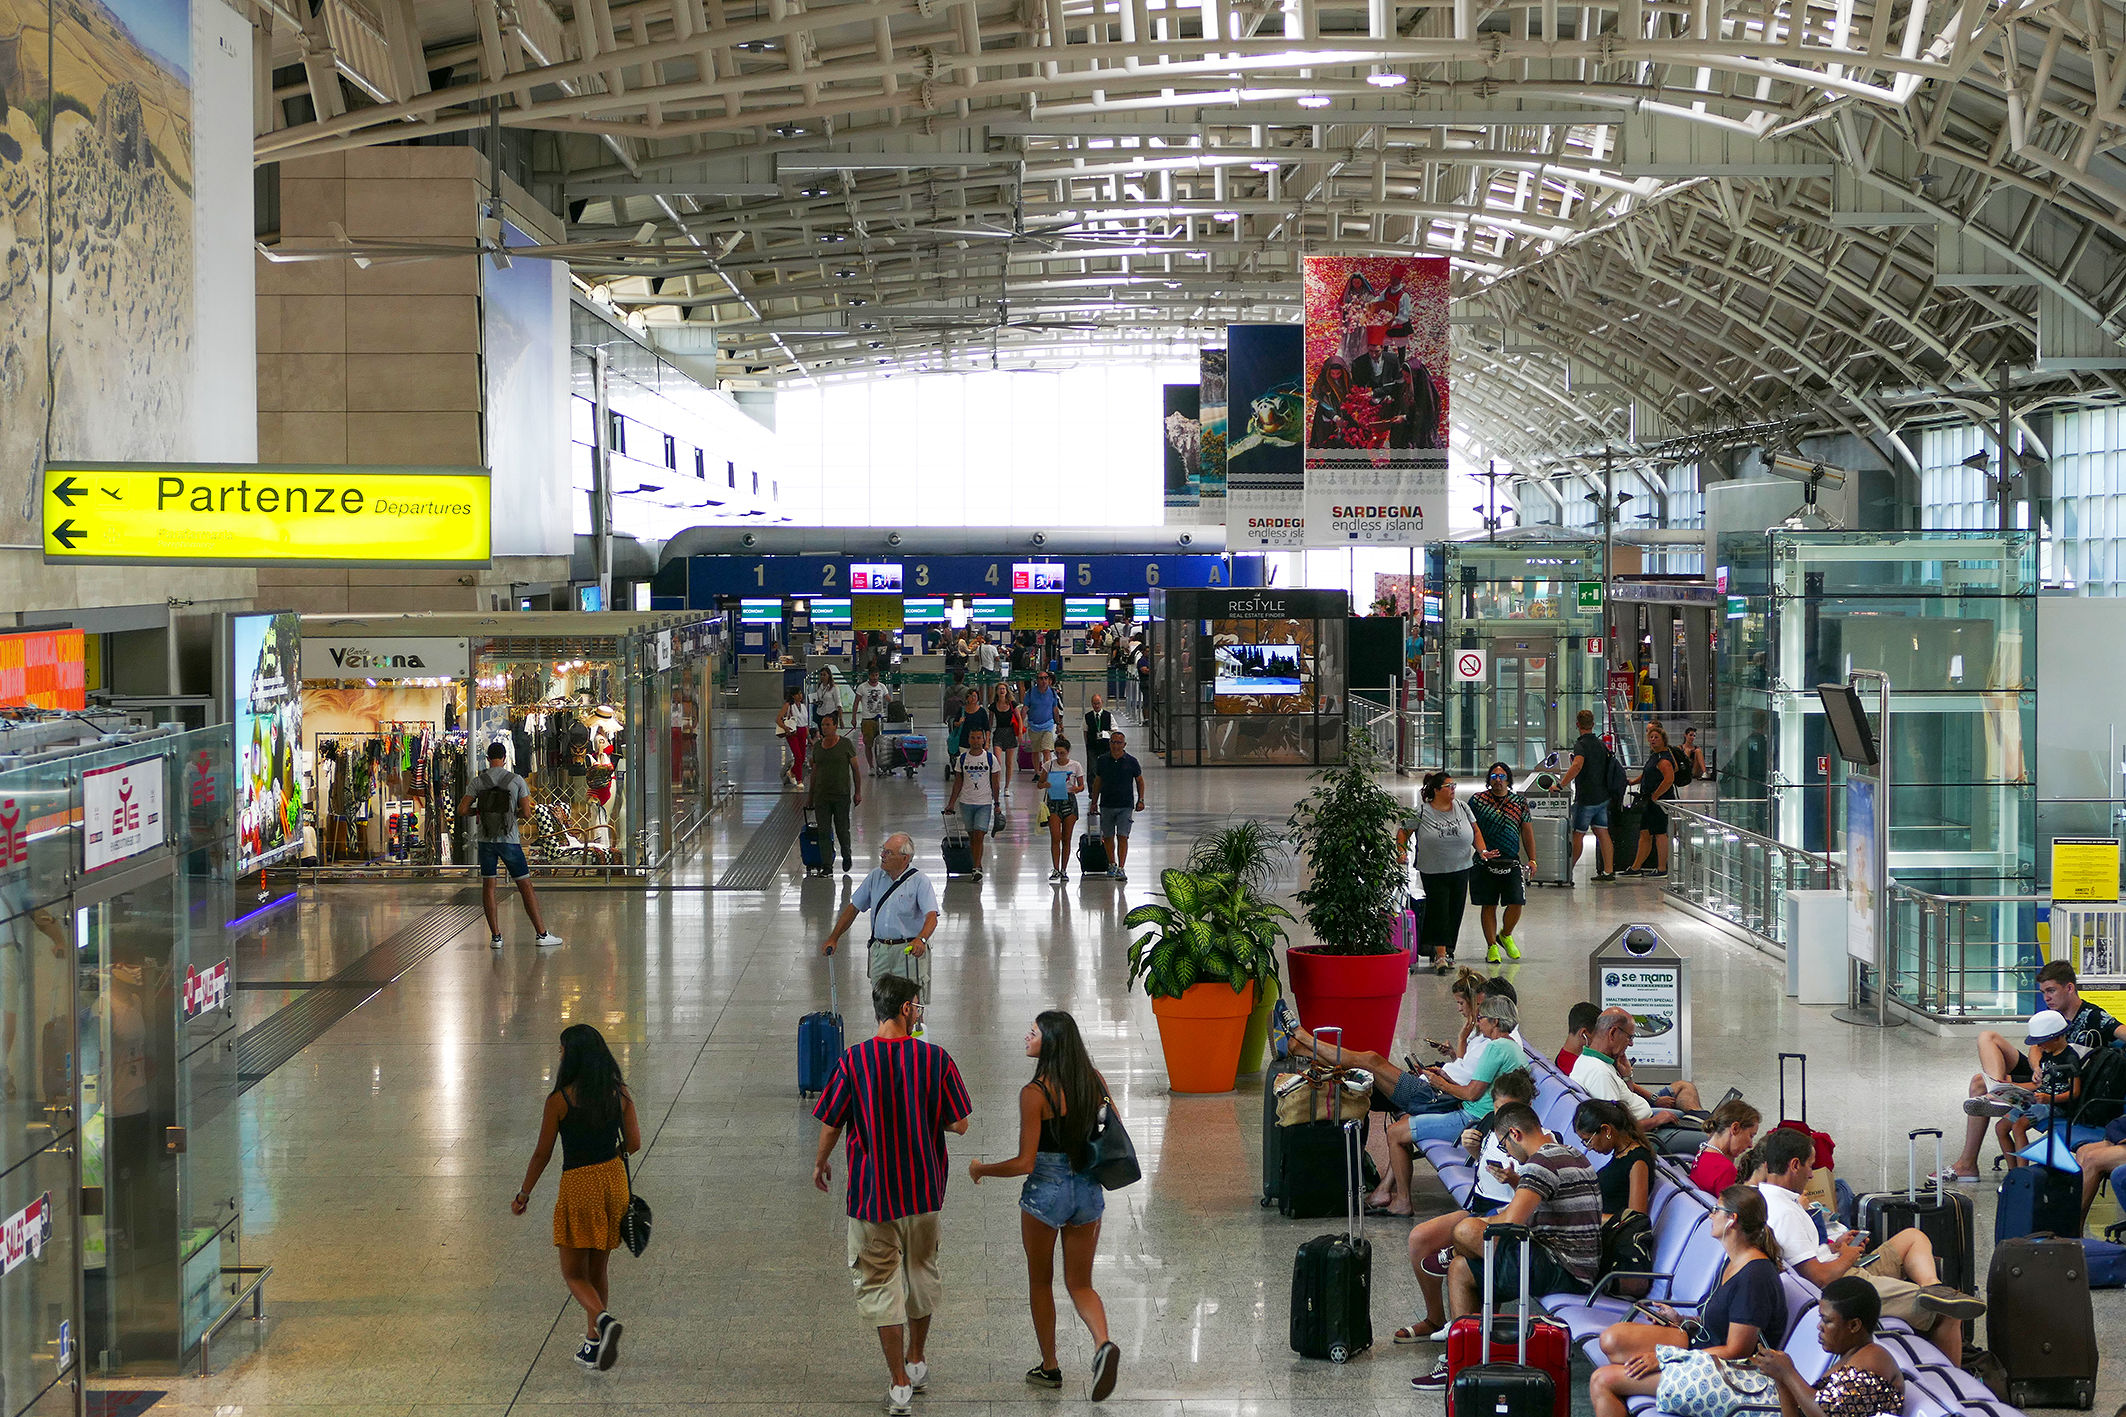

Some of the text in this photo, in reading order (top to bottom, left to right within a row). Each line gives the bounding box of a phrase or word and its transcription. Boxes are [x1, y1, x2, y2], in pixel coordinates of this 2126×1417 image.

[158, 477, 471, 518] Partenze Departures
[1332, 506, 1424, 518] SARDEGNA
[1248, 529, 1287, 538] endless
[1332, 518, 1424, 531] endless island
[753, 564, 764, 587] 1
[822, 564, 837, 587] 2
[915, 564, 930, 587] 3
[985, 564, 999, 586] 4
[1078, 563, 1091, 586] 5
[1146, 563, 1159, 586] 6
[1208, 565, 1221, 583] A
[1228, 597, 1285, 611] RESTYLE
[329, 648, 426, 668] Verona
[112, 777, 140, 836] EYE
